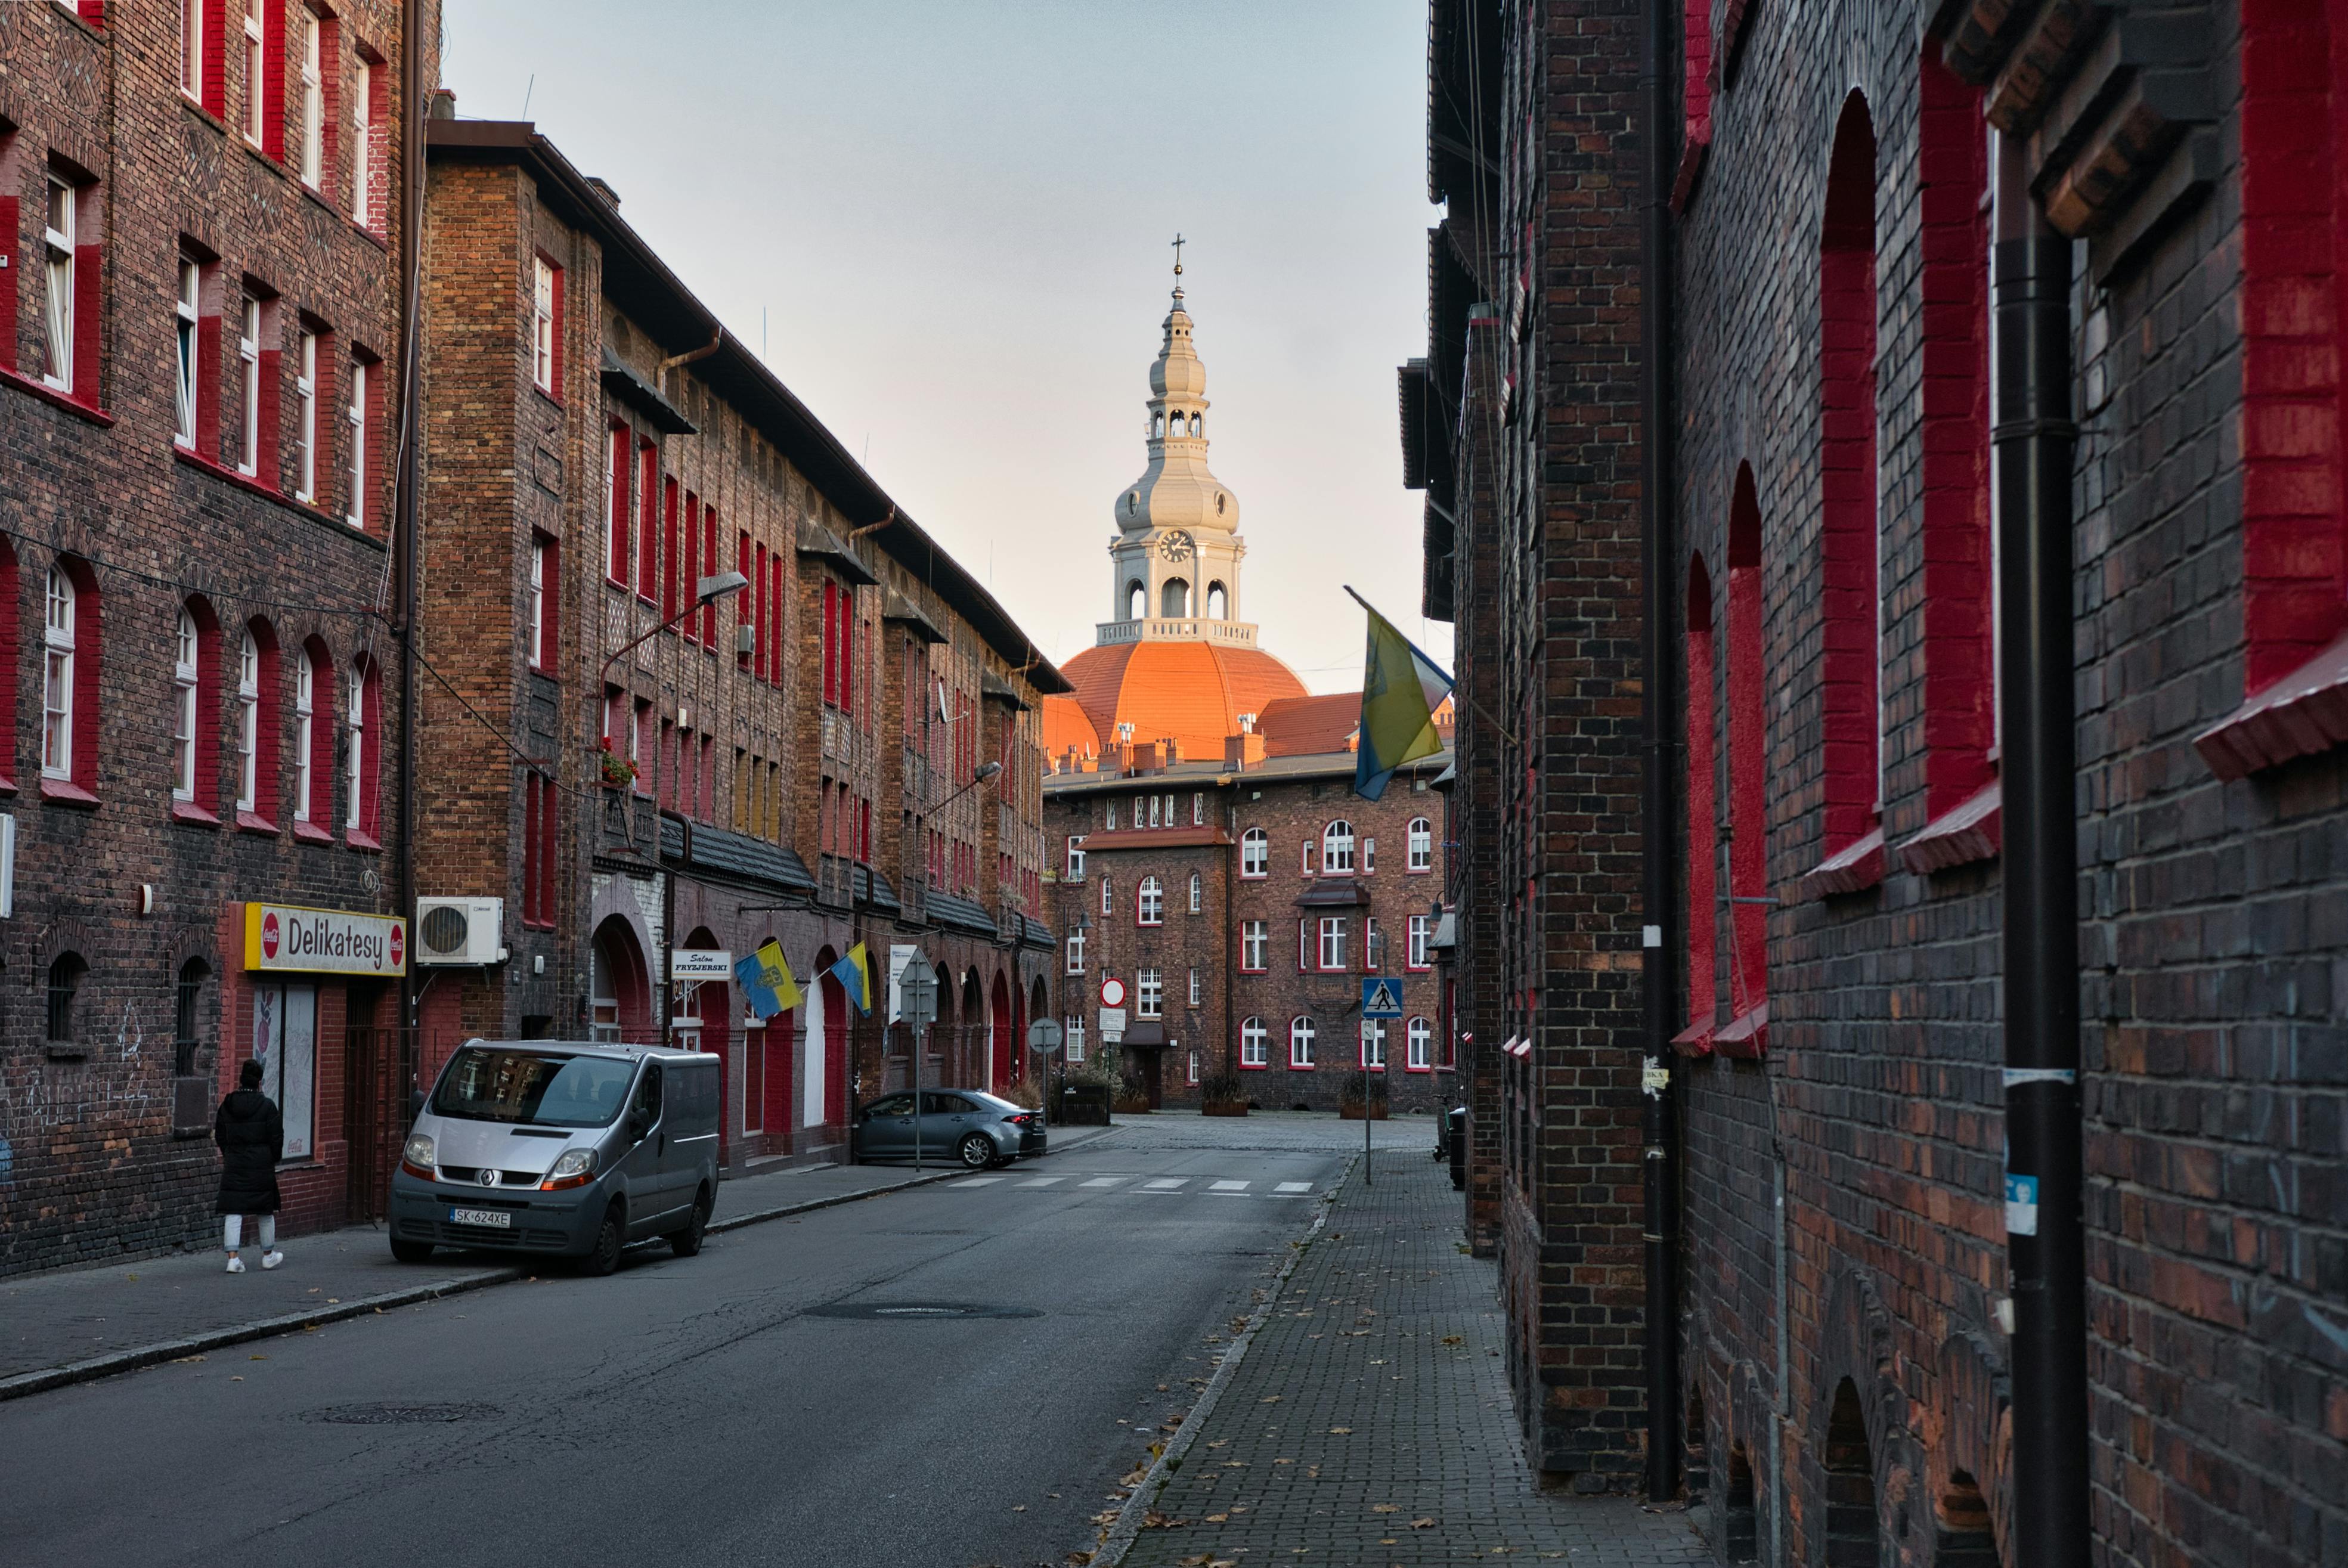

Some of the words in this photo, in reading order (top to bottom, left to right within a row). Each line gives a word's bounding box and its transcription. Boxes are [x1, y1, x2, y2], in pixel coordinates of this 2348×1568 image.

[289, 918, 383, 970] Delikatesy
[690, 954, 714, 962] Salon
[457, 1210, 470, 1222] SK
[475, 1211, 508, 1225] 624XE
